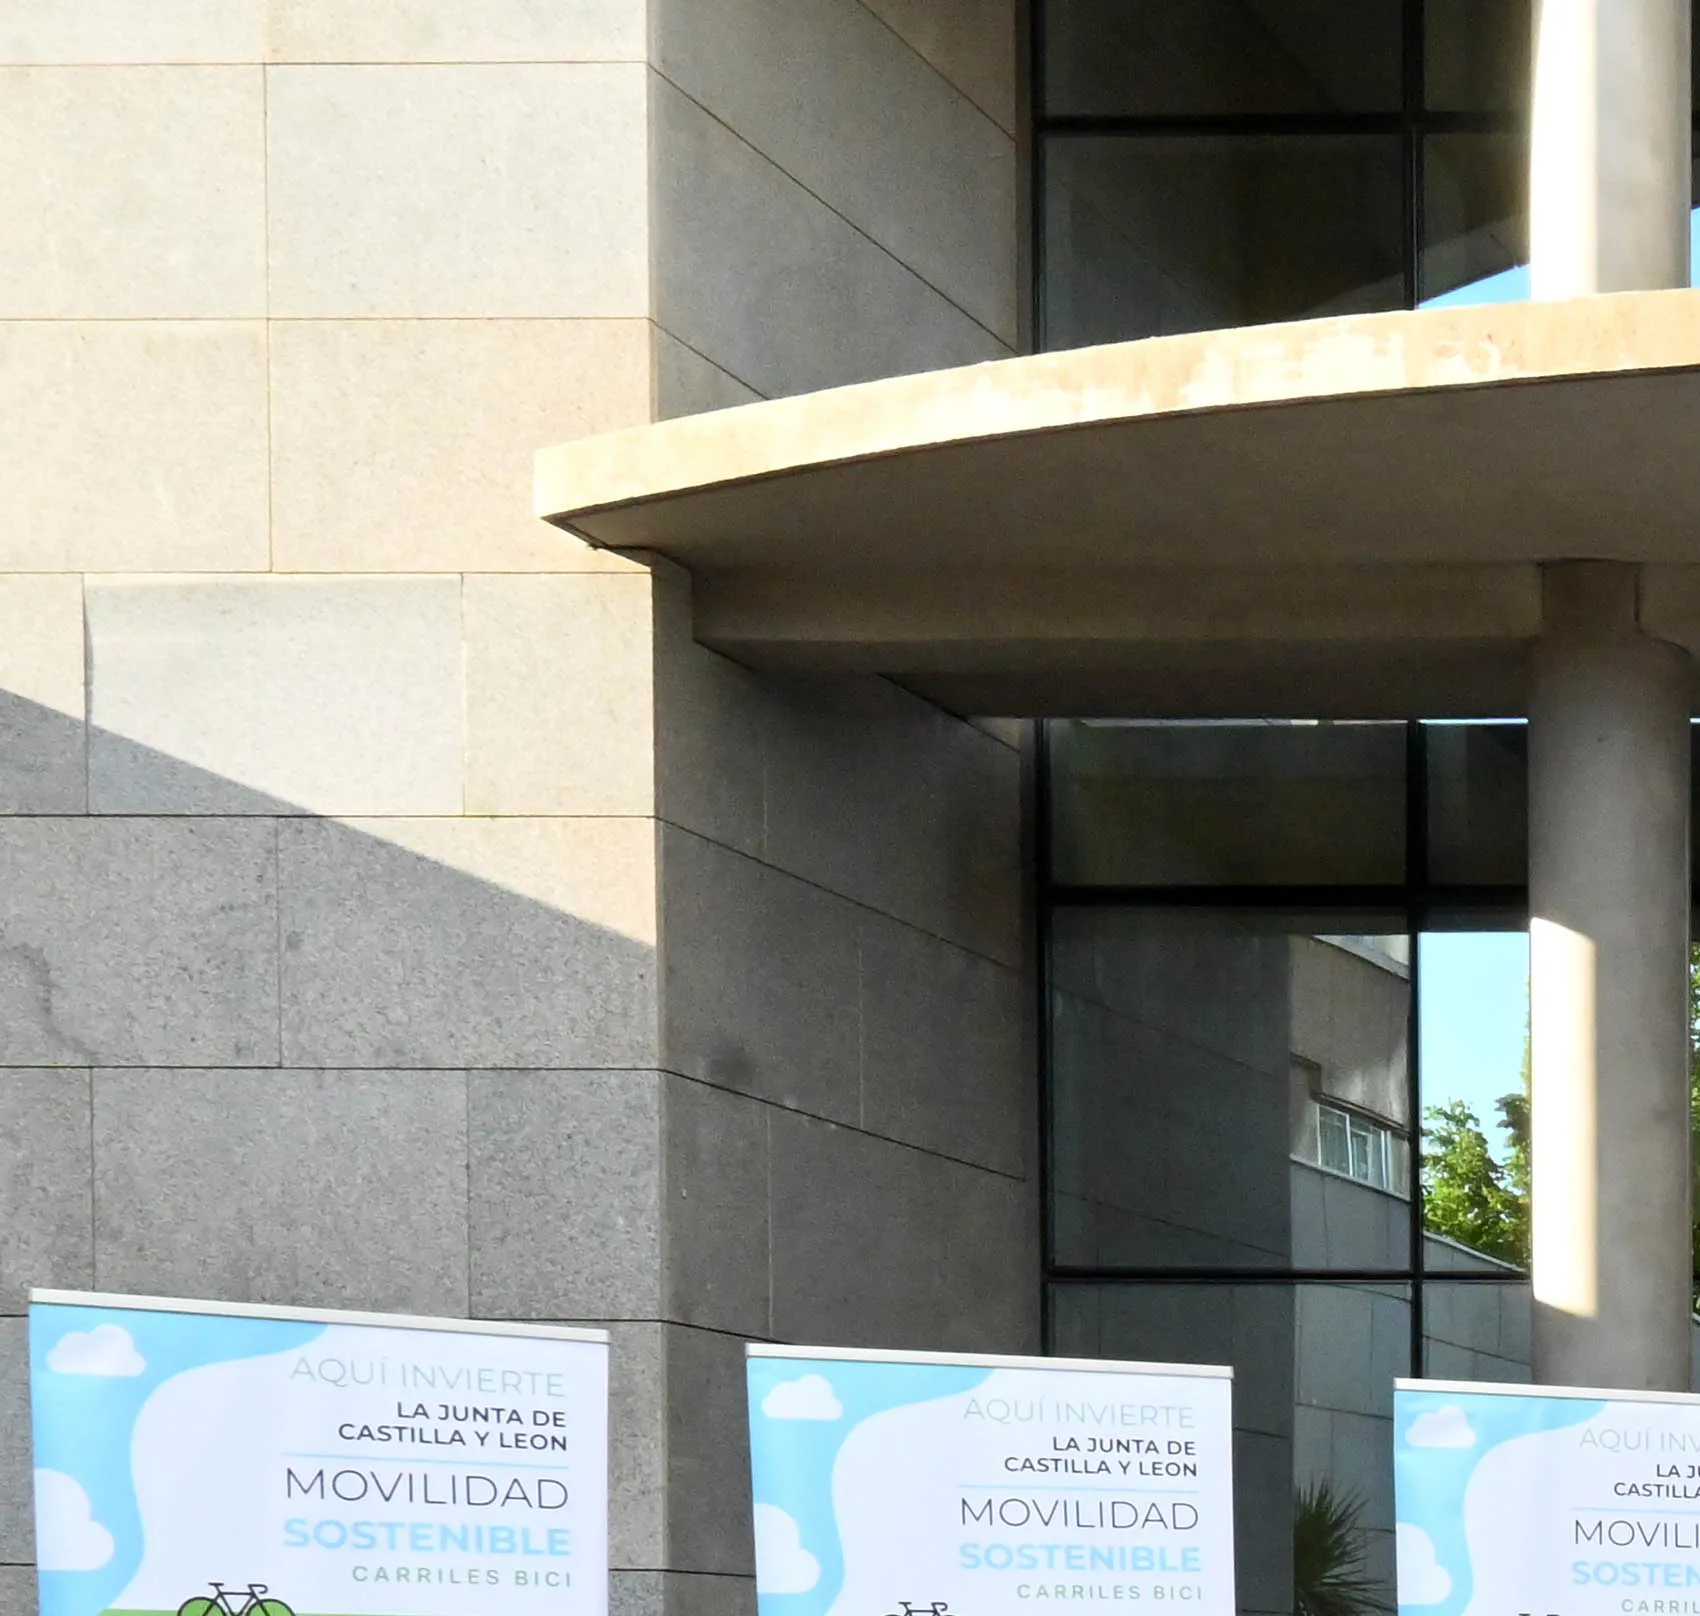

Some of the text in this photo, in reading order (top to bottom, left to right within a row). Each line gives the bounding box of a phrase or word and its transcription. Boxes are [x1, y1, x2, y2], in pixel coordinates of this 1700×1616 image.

[289, 1355, 566, 1398] AQUÍ INVIERTE
[397, 1401, 566, 1428] LA JUNTA DE
[338, 1423, 567, 1452] CASTILLA Y LEON
[1052, 1436, 1196, 1456] LA JUNTA DE
[1004, 1456, 1197, 1477] CASTILLA Y LEON
[1656, 1463, 1681, 1478] LA
[286, 1467, 569, 1510] MOVILIDAD
[961, 1497, 1199, 1531] MOVILIDAD
[283, 1517, 572, 1557] SOSTENIBLE
[958, 1542, 1202, 1573] SOSTENIBLE
[351, 1565, 571, 1588] CARRILES BICI
[1016, 1583, 1202, 1601] CARRILES BICI
